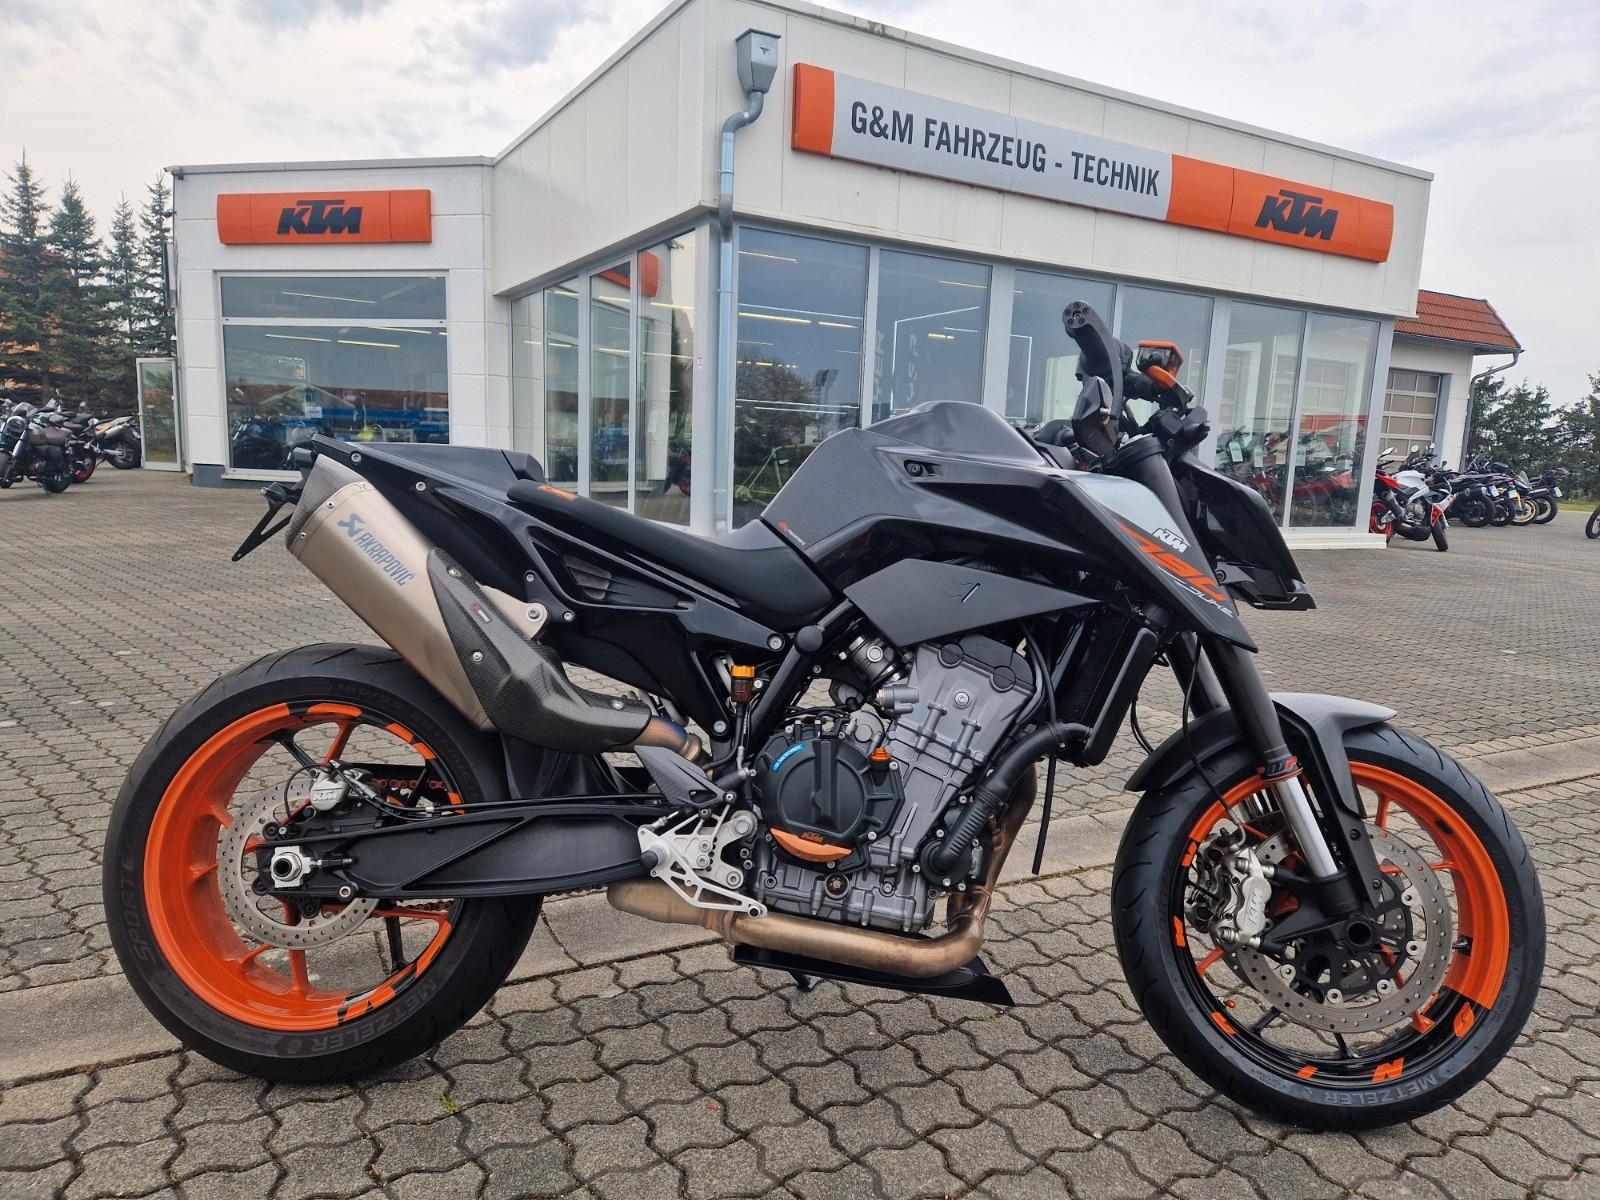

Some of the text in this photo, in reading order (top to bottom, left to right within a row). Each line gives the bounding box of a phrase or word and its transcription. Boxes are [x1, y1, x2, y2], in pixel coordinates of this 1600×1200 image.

[851, 101, 914, 145] G&M
[923, 117, 1047, 173] FAHRZEUG
[1071, 151, 1161, 197] TECHNIK
[276, 199, 363, 234] KTM
[1254, 188, 1339, 241] KTM
[1152, 527, 1192, 554] KTM
[311, 980, 438, 1052] METZELER
[1324, 1072, 1440, 1105] METZELER
